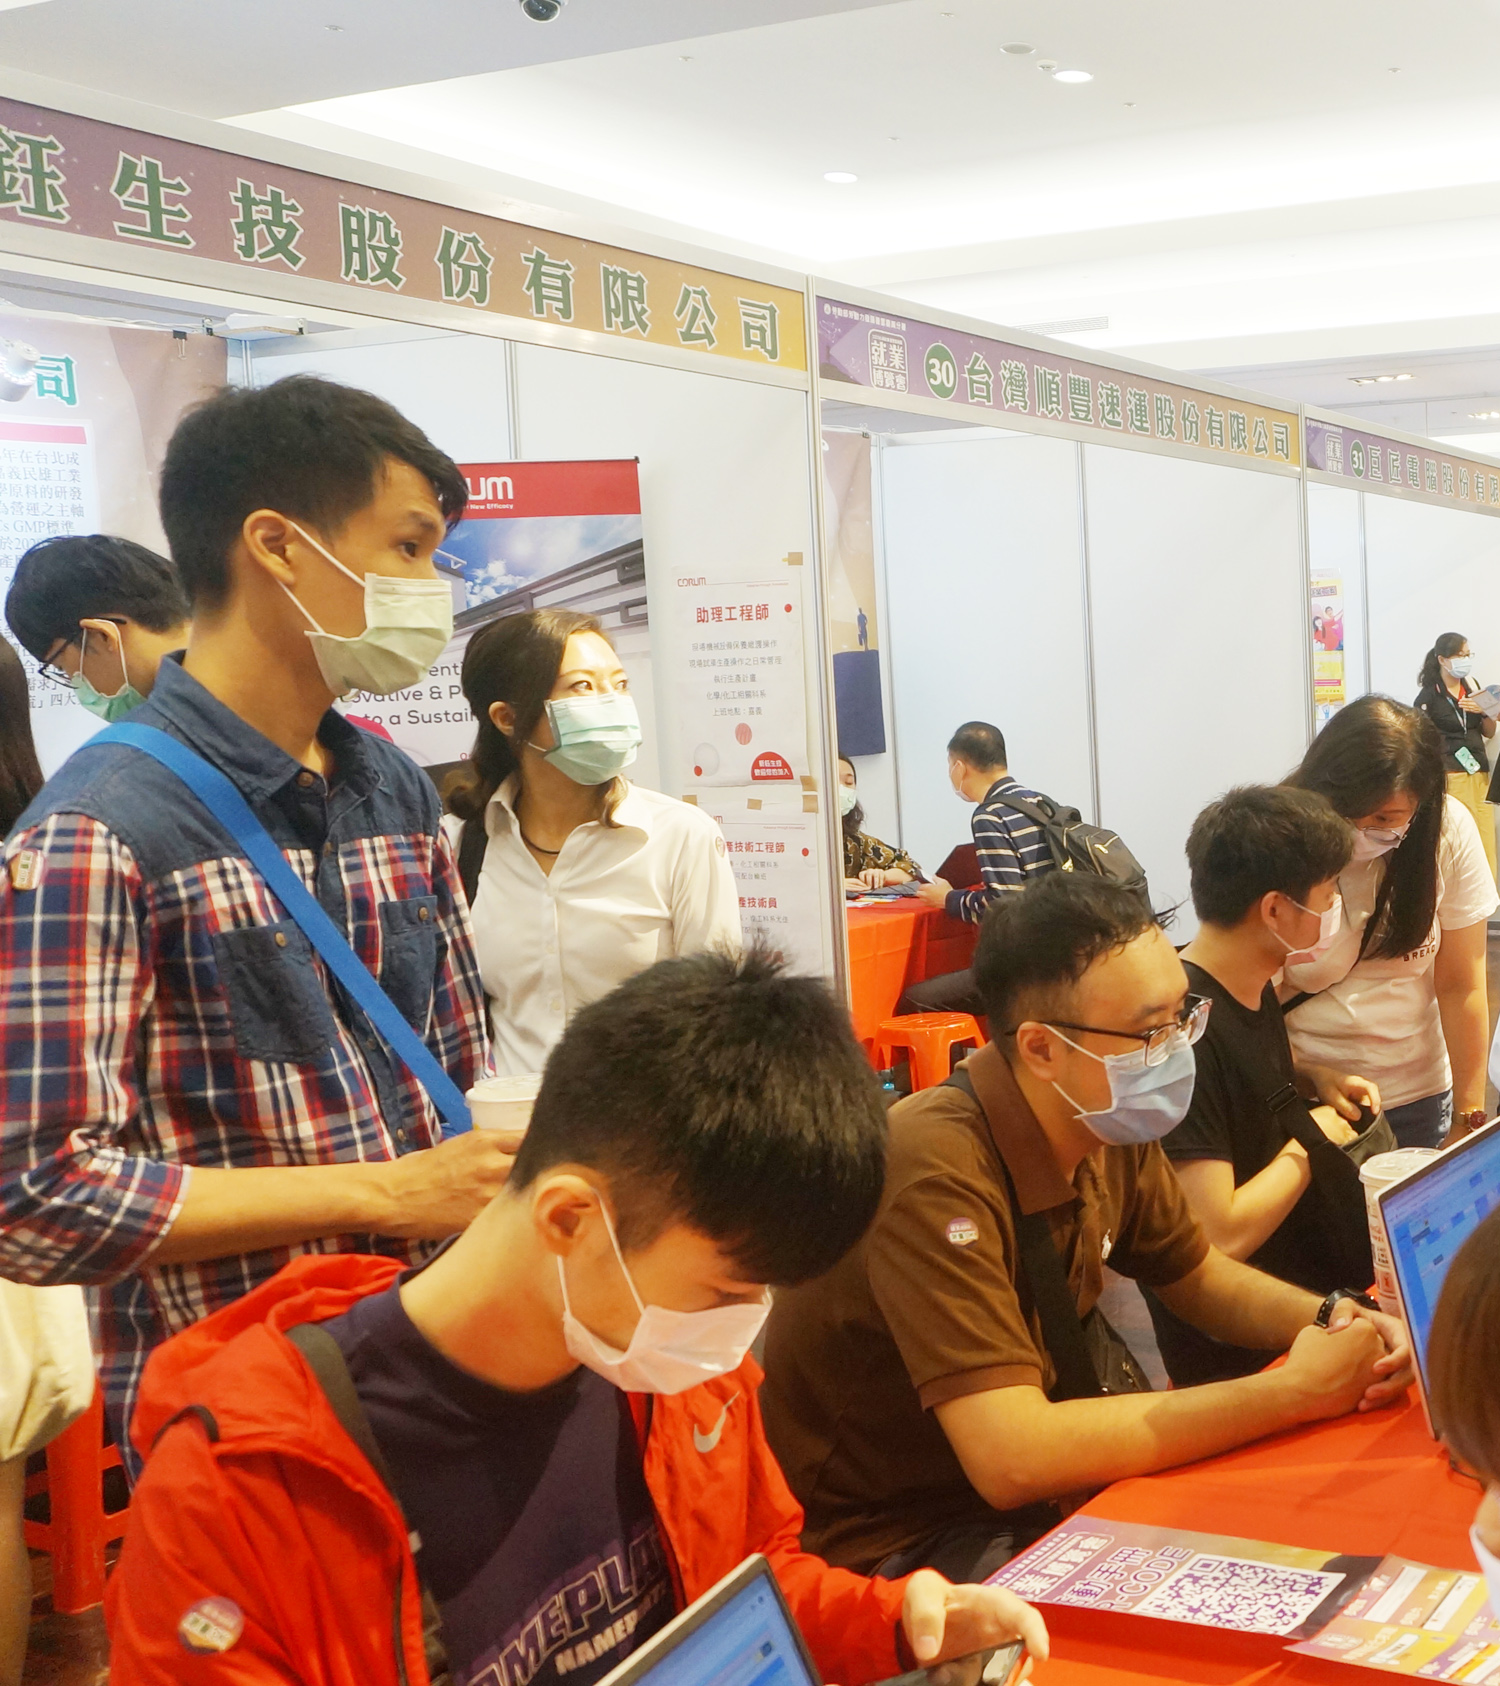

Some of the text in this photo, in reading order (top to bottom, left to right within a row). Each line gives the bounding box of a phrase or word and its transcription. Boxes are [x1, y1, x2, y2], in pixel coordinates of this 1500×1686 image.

[871, 340, 905, 369] 就業
[929, 349, 1292, 462] 30 台灣順豐速運股份有限公司
[1352, 450, 1364, 470] 31
[696, 603, 769, 623] 助理工程師
[429, 685, 442, 700] &
[389, 715, 401, 725] a
[407, 710, 474, 724] Sustai
